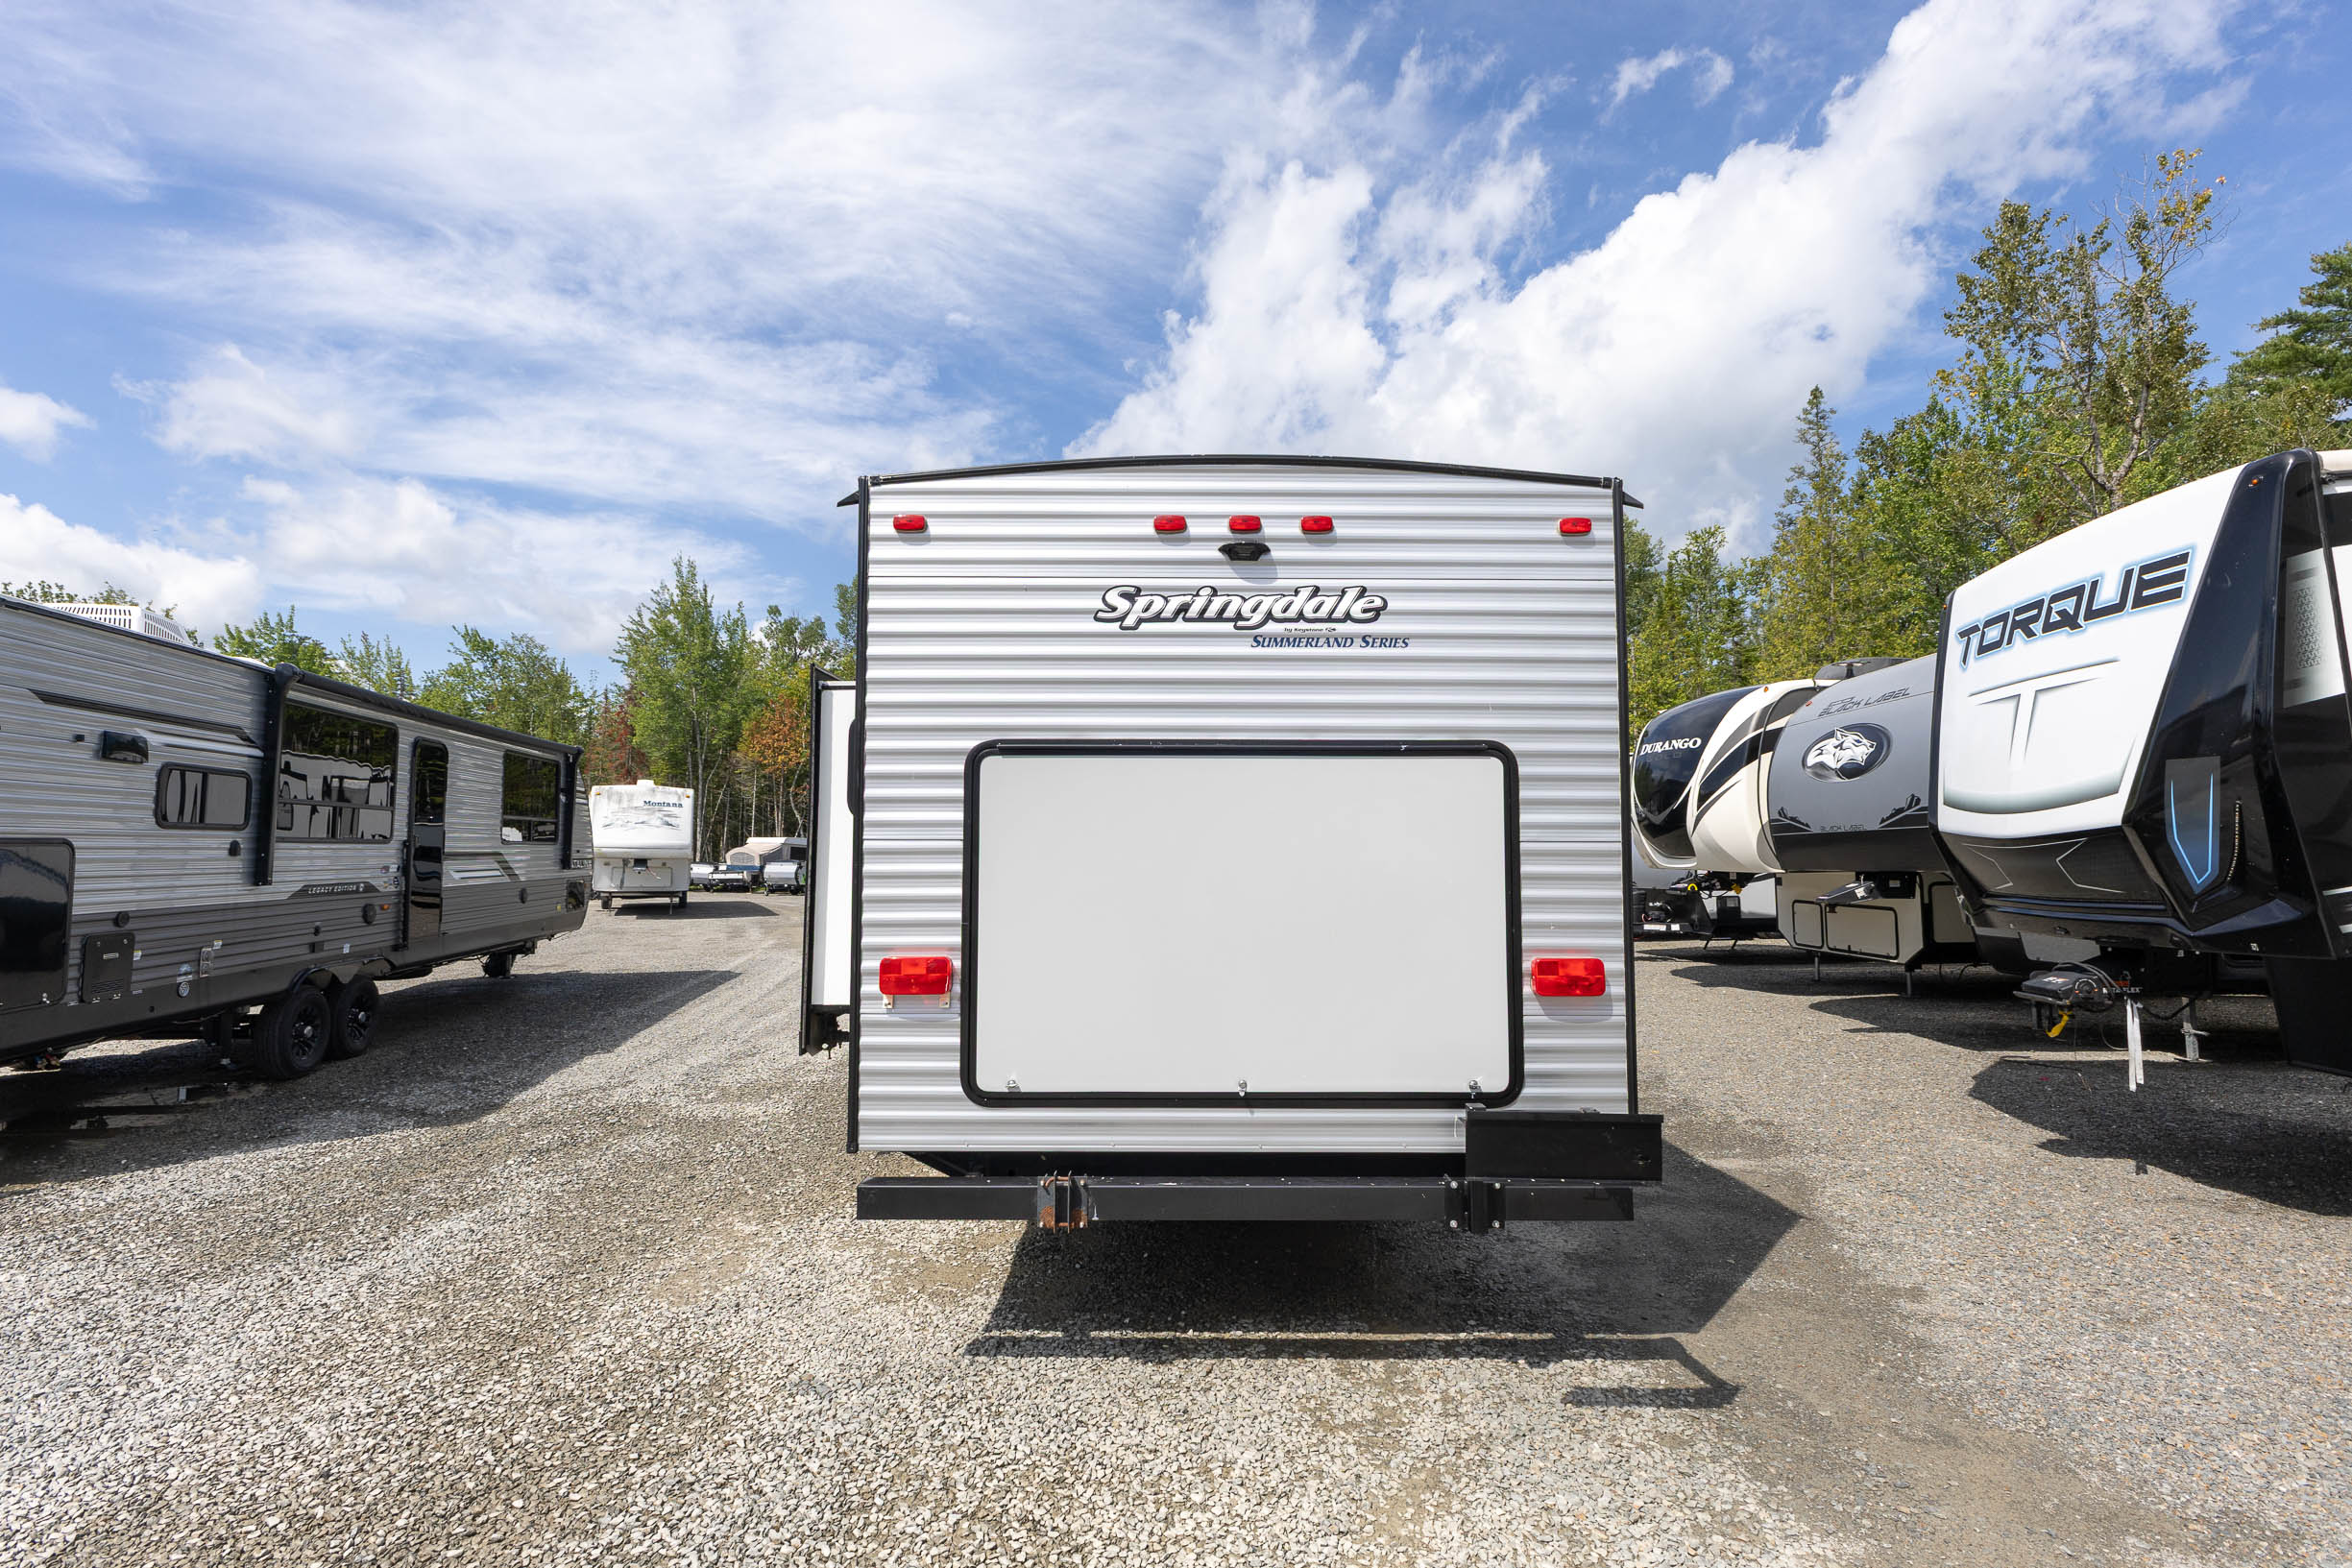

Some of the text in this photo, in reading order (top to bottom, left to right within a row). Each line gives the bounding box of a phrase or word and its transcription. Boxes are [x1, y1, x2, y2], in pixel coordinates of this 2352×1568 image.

[1094, 585, 1389, 631] Springdale
[1956, 548, 2193, 667] TORQUE
[1250, 635, 1410, 648] SUMMERLAND SERIES
[1864, 687, 1911, 707] LABEL
[1639, 737, 1702, 757] DURANGO
[643, 800, 684, 808] Montana
